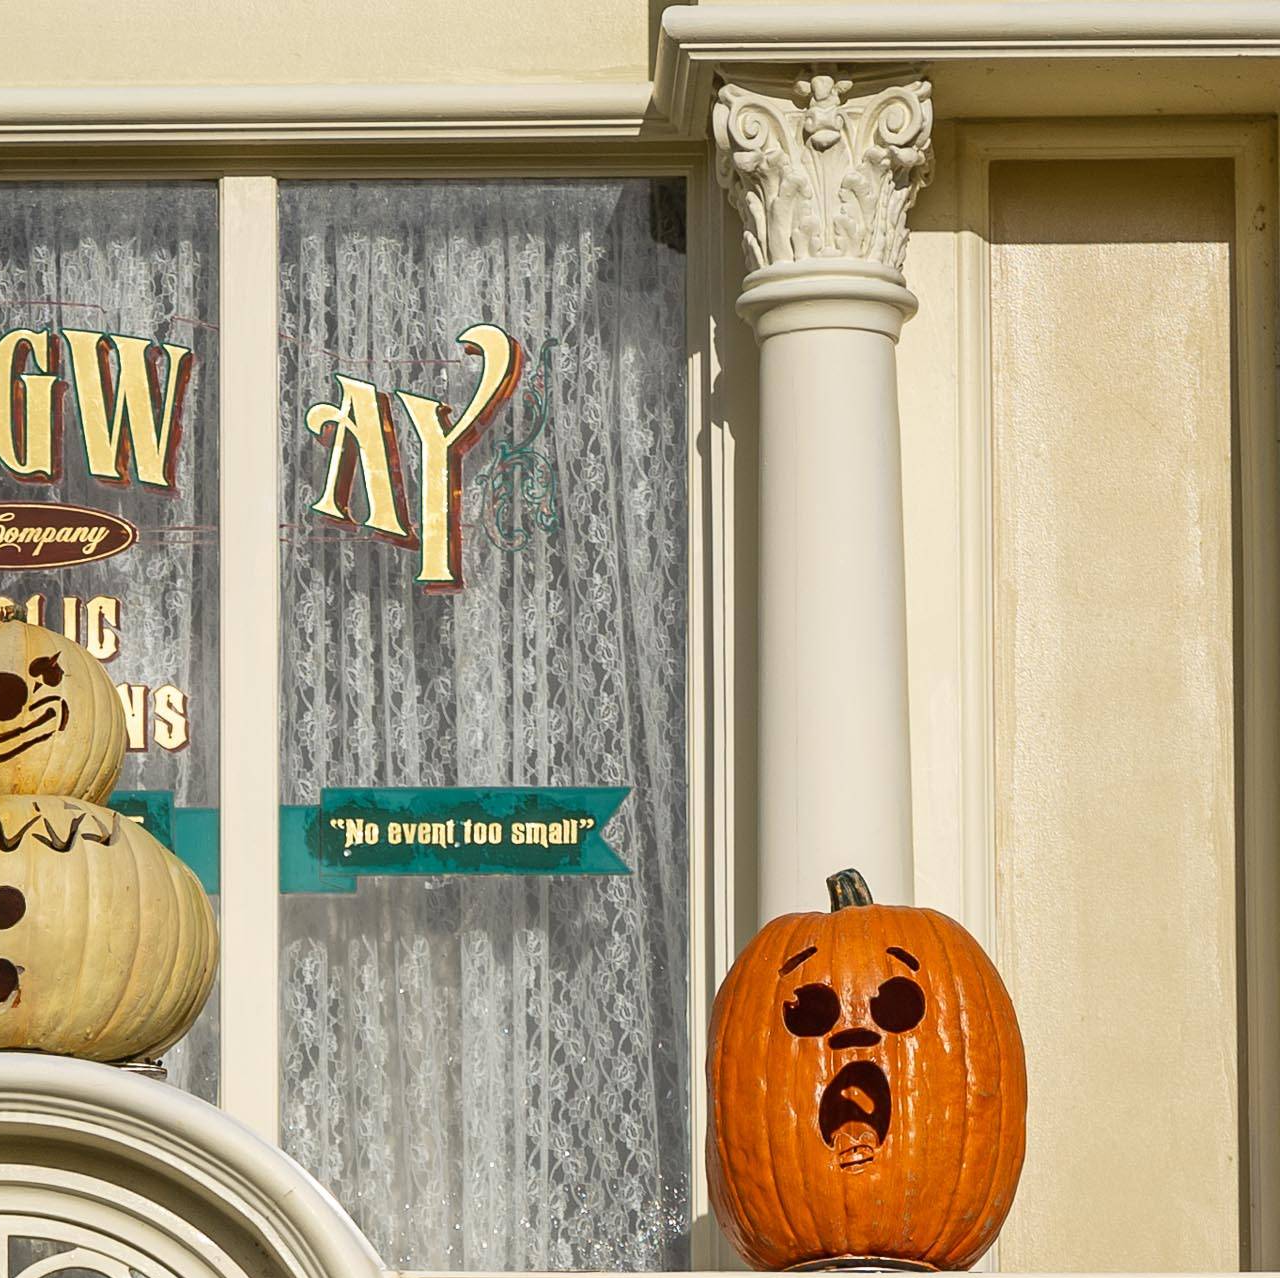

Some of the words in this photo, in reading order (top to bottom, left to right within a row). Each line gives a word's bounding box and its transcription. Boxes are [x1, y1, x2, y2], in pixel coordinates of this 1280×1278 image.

[330, 818, 379, 848] “No
[387, 818, 456, 848] event
[464, 819, 503, 845] too
[511, 818, 595, 848] small”
